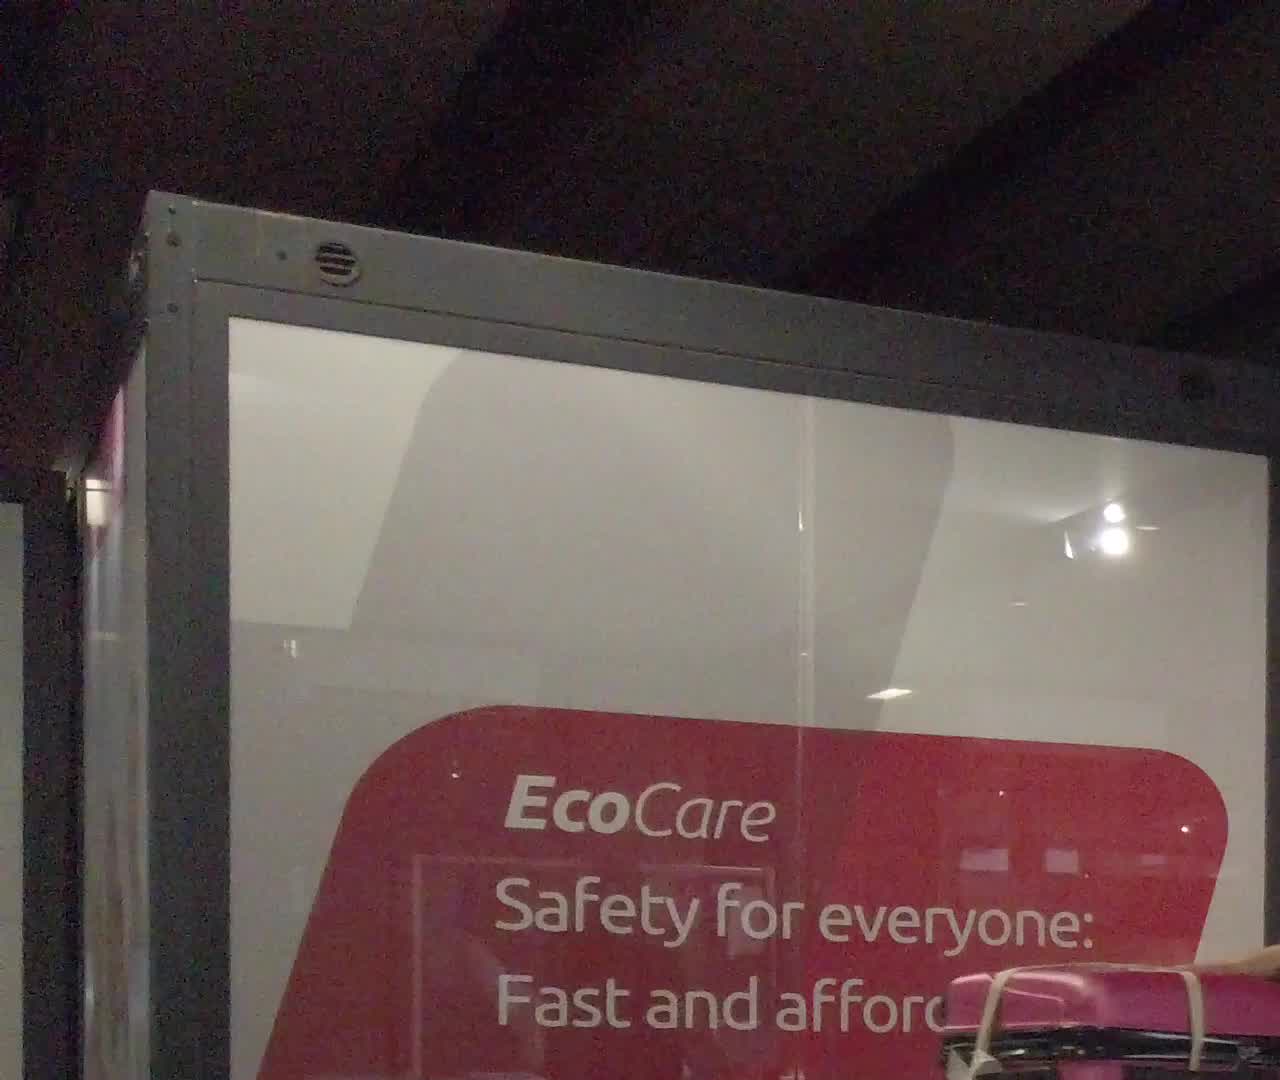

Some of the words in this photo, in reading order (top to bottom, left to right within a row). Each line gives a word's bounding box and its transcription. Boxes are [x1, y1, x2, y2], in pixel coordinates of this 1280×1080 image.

[504, 774, 776, 842] EcoCare
[495, 876, 699, 948] Safety
[717, 882, 804, 940] for
[818, 904, 1095, 956] everyone:
[499, 973, 630, 1030] Fast
[646, 975, 758, 1031] and
